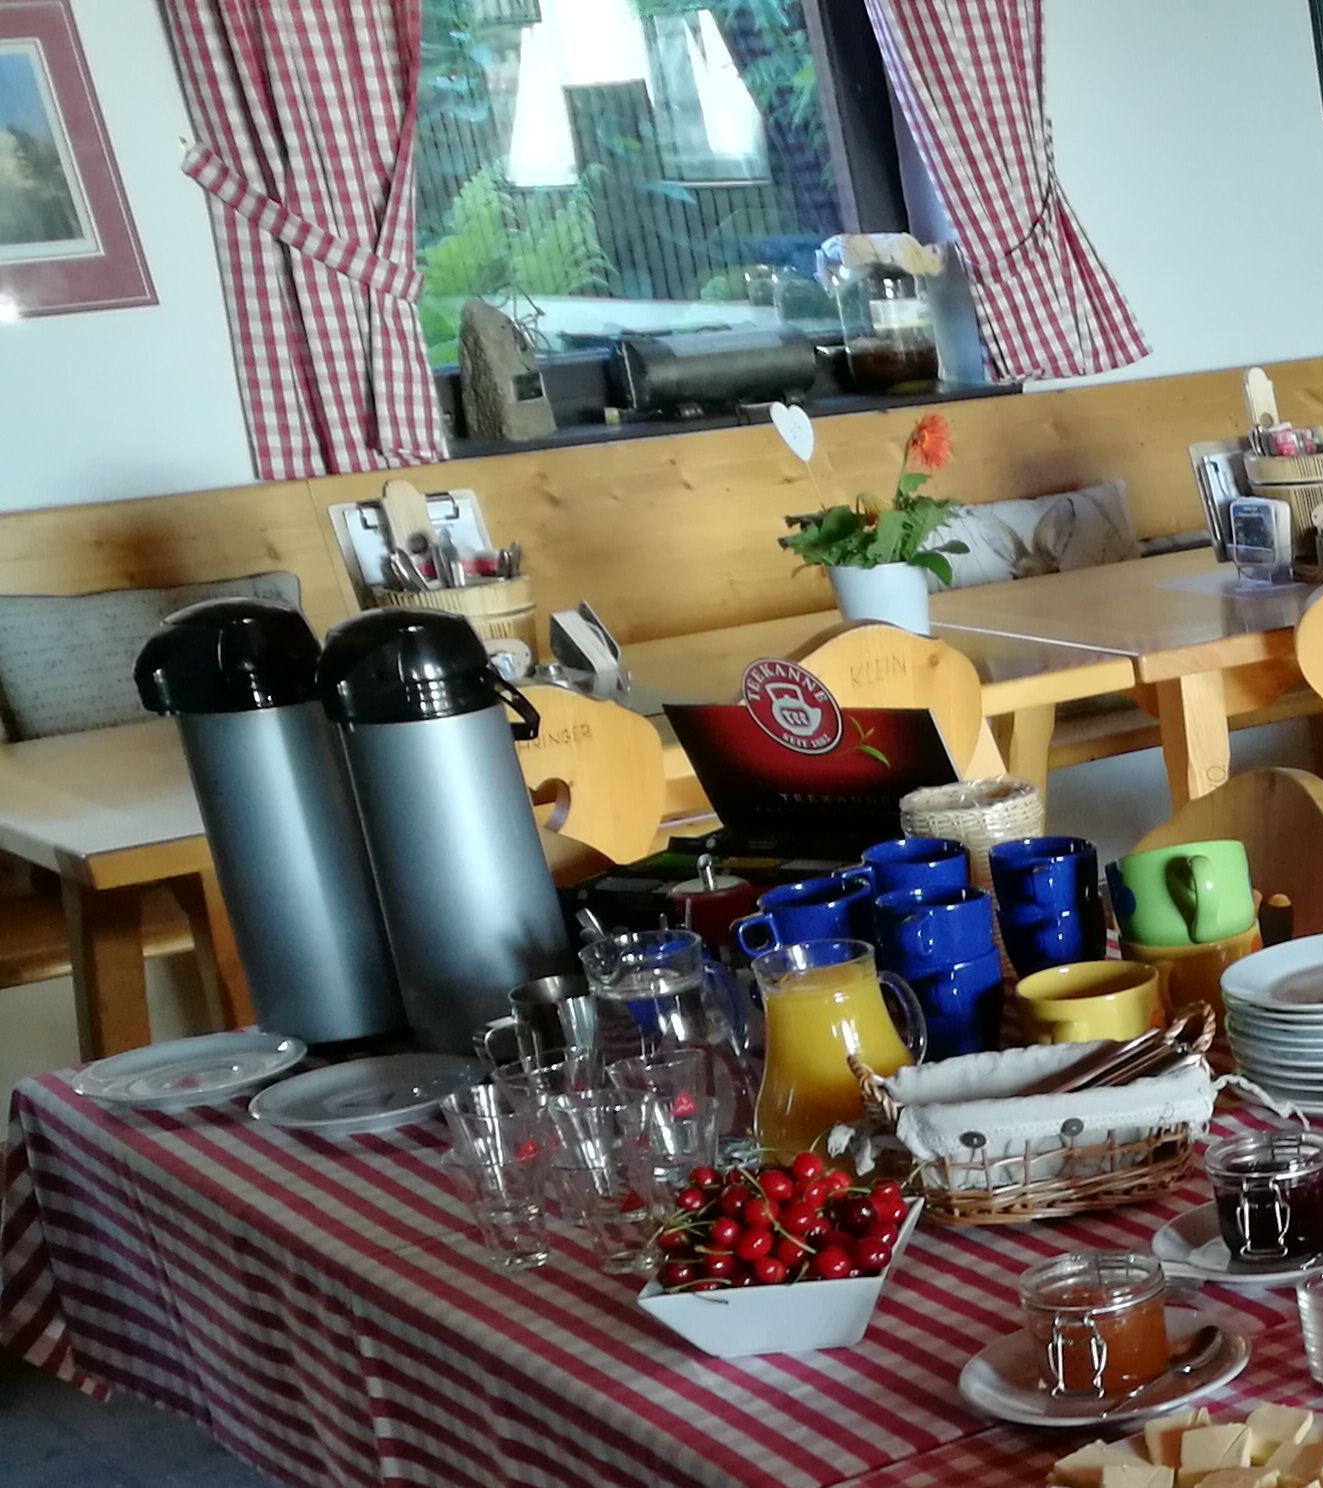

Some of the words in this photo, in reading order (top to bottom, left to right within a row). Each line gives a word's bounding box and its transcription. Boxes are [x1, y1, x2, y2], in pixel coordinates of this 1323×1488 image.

[746, 662, 829, 703] TEEKANNE
[849, 652, 907, 688] KLEIN
[782, 733, 808, 748] SEIT
